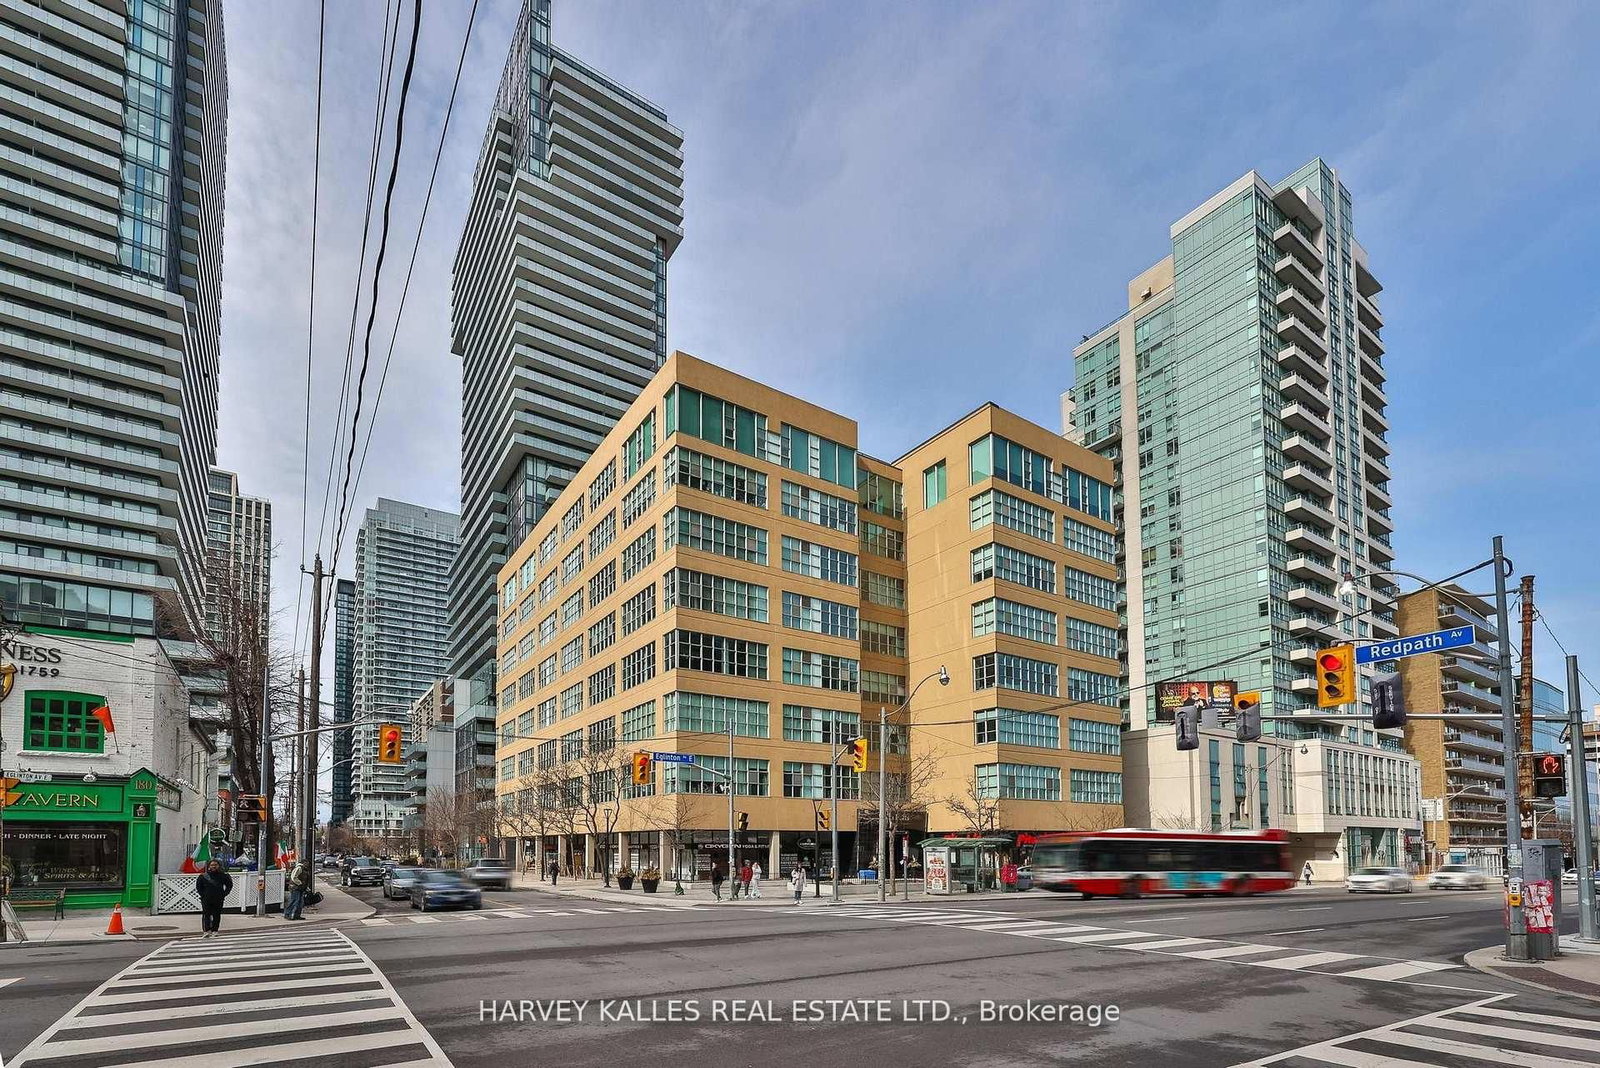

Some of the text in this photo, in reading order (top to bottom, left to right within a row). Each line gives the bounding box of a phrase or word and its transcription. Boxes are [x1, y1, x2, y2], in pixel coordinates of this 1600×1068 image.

[1370, 630, 1463, 659] Redpath Av
[20, 665, 60, 677] 1759
[655, 753, 681, 762] Eglinton
[16, 792, 99, 807] AVERN
